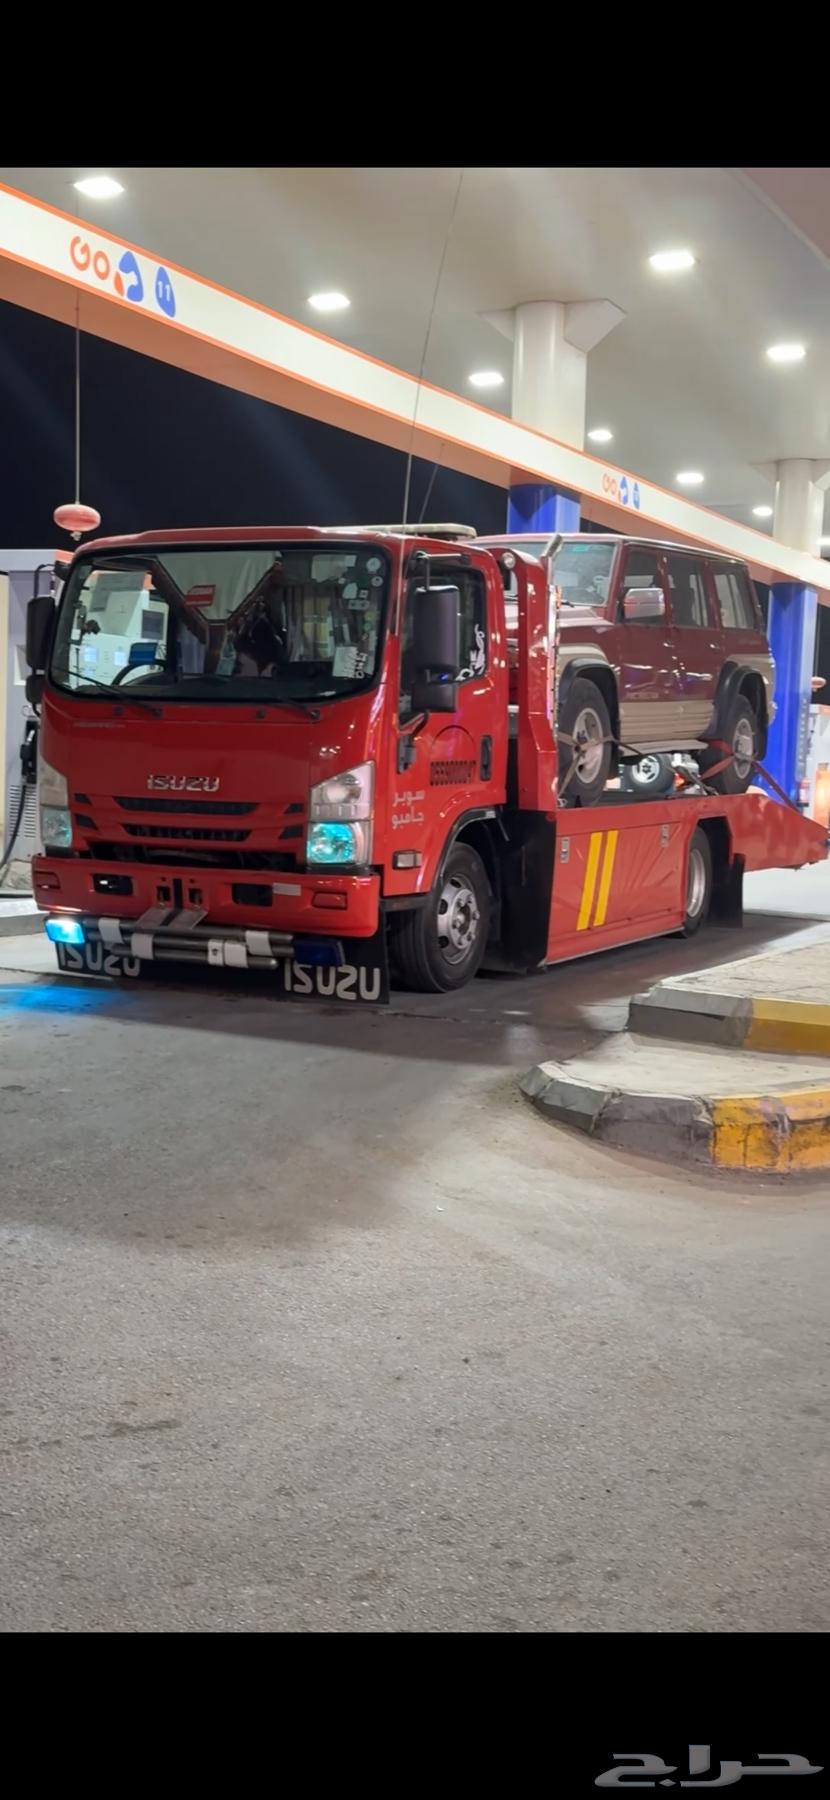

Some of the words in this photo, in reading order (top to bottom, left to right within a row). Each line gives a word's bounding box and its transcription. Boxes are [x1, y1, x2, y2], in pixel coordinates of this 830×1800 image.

[70, 235, 110, 280] GO
[147, 775, 220, 792] ISUZU
[391, 789, 426, 808] سوبر
[391, 806, 425, 830] جامبو
[58, 942, 141, 977] ISUZU
[284, 957, 381, 1001] ISUZU
